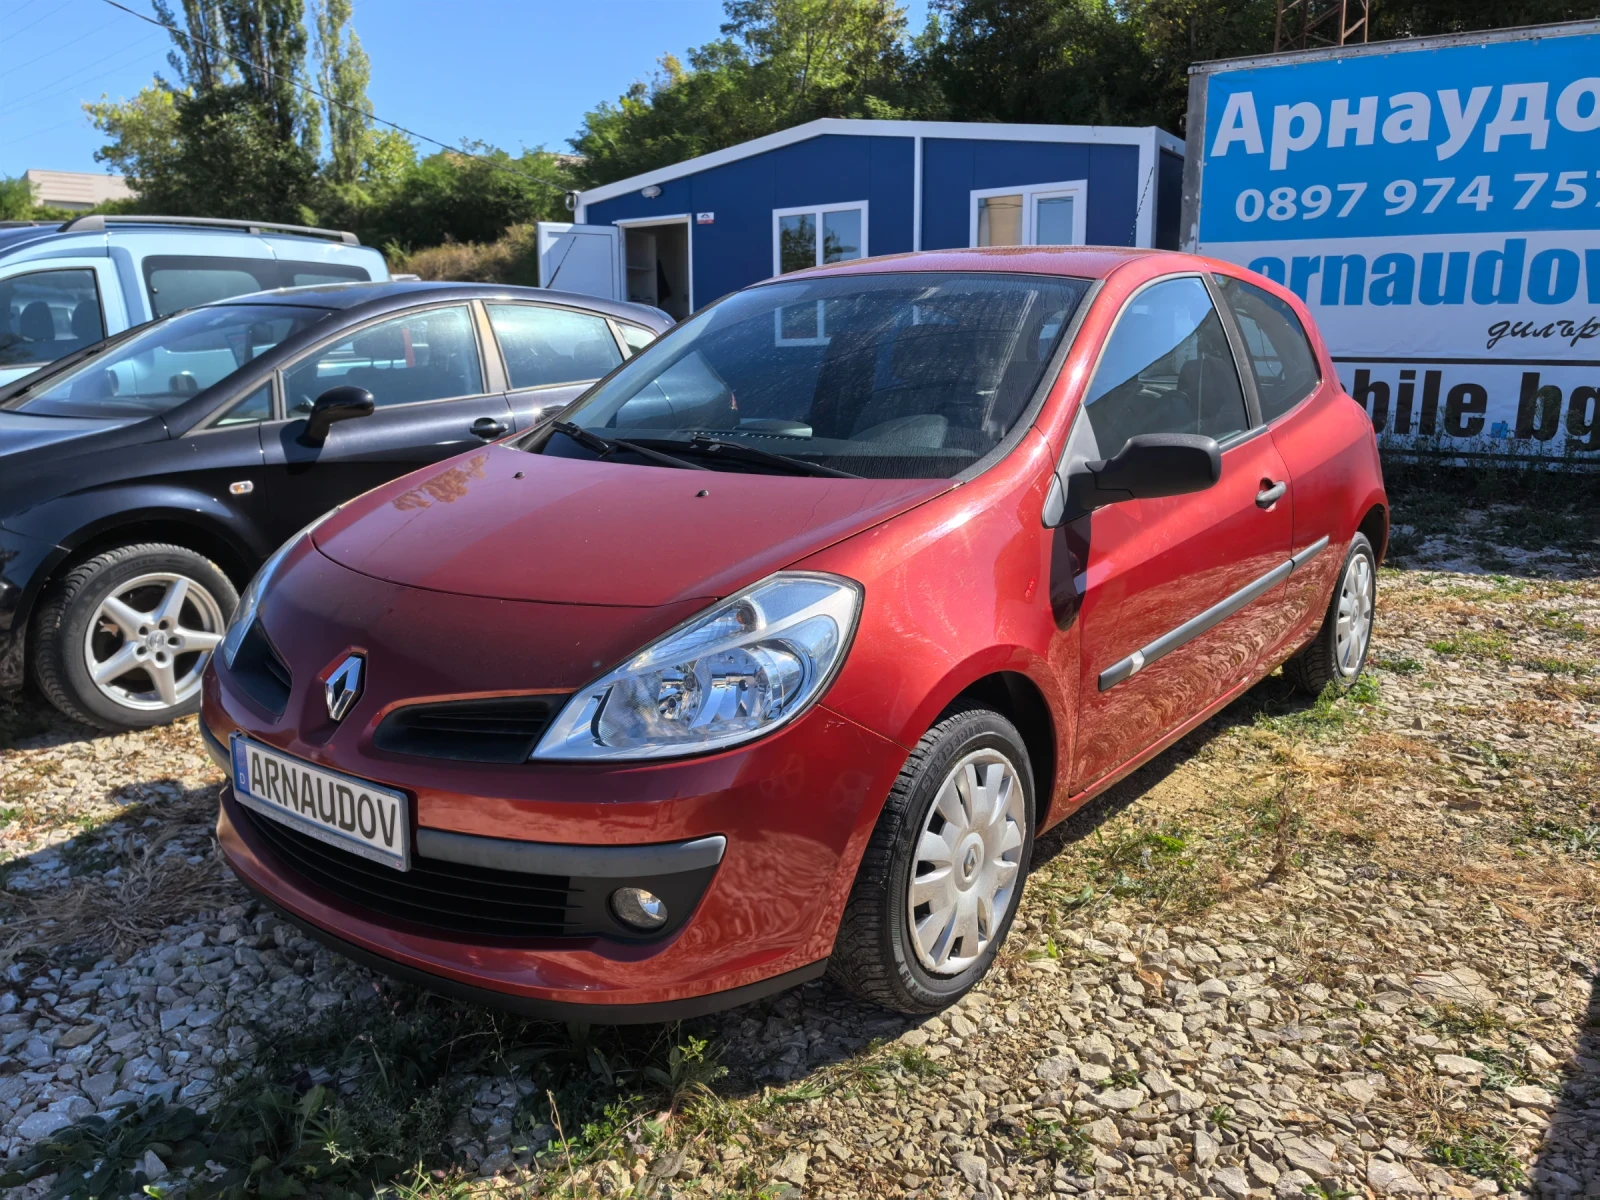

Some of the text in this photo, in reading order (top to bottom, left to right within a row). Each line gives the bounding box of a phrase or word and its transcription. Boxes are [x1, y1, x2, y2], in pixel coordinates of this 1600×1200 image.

[1210, 77, 1600, 171] Арнаудо
[1235, 170, 1600, 223] 0897 974 75
[239, 772, 246, 785] D
[251, 751, 396, 848] ARNAUDOV
